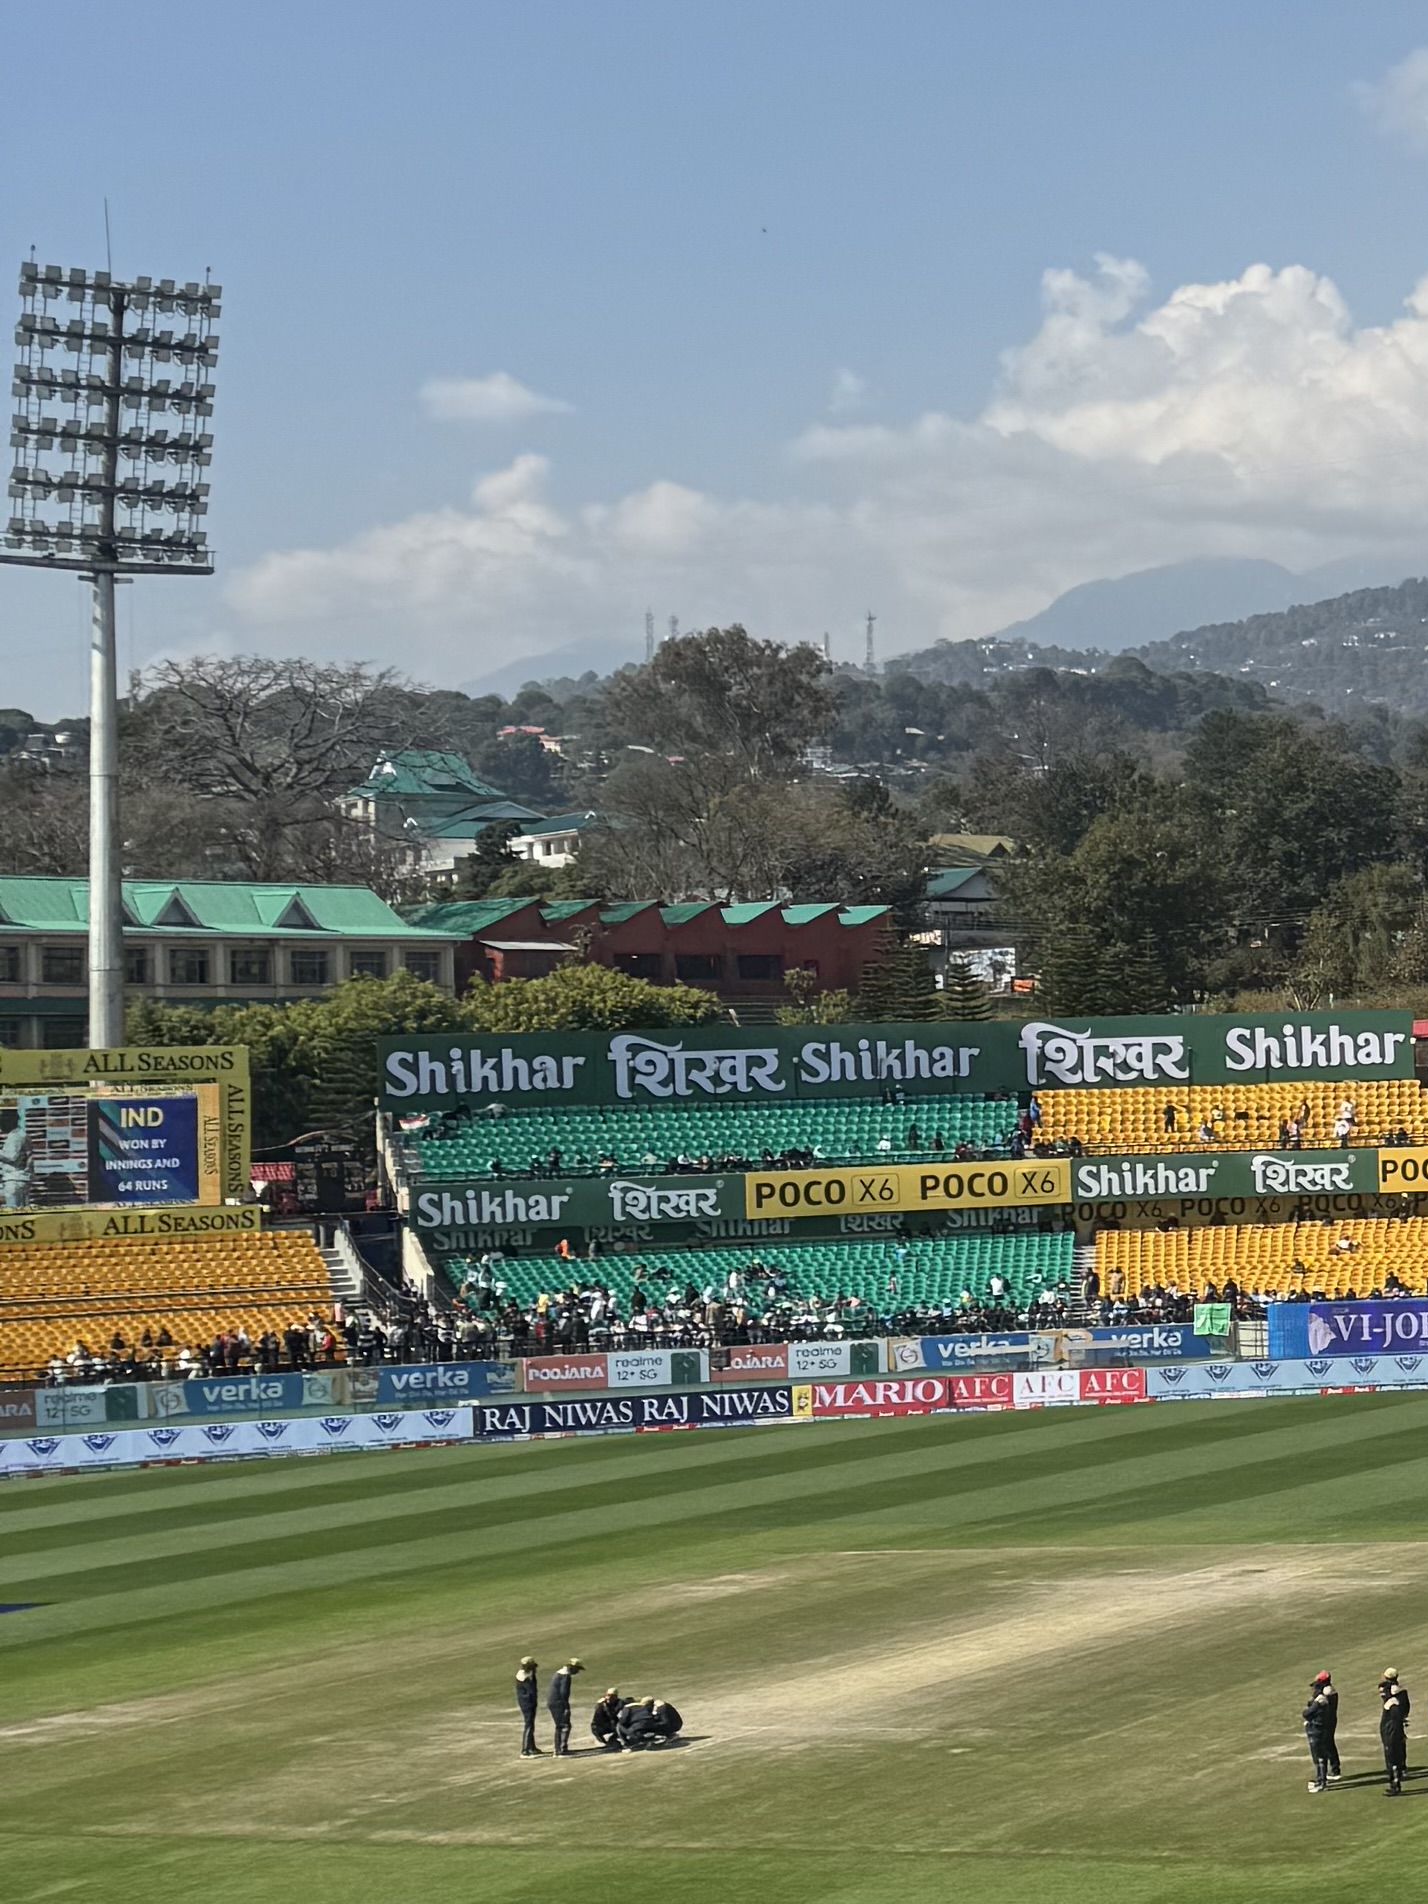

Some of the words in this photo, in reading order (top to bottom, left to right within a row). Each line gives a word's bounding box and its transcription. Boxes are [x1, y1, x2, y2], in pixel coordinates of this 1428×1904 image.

[84, 1052, 135, 1074] ALL
[138, 1050, 236, 1073] SEASONS
[801, 1038, 981, 1085] Shikhar
[1019, 1022, 1191, 1085] शिखर
[1225, 1023, 1406, 1071] Shikhar
[386, 1047, 586, 1097] Shikhar
[608, 1034, 787, 1098] शिखर
[120, 1106, 165, 1129] IND
[227, 1084, 244, 1122] ALL
[118, 1138, 150, 1150] WON
[151, 1138, 168, 1149] BY
[227, 1123, 244, 1193] SEASONS
[105, 1159, 153, 1171] INNINGS
[154, 1158, 181, 1169] AND
[1077, 1161, 1216, 1198] Shikhar
[1250, 1154, 1354, 1195] शिखर
[118, 1180, 133, 1192] 64
[135, 1179, 169, 1191] RUNS
[755, 1179, 846, 1209] POCO
[858, 1177, 895, 1202] X6
[919, 1171, 1008, 1200] POCO
[1020, 1170, 1055, 1195] X6
[417, 1189, 570, 1228] Shikhar
[608, 1180, 722, 1222] शिखर
[103, 1215, 152, 1236] ALL
[157, 1210, 255, 1234] SEASONS
[615, 1356, 663, 1367] realme
[795, 1346, 843, 1358] realme
[203, 1377, 283, 1403] verka
[391, 1366, 469, 1390] verka
[954, 1374, 1010, 1398] AFC
[1020, 1373, 1076, 1396] AFC
[1085, 1370, 1142, 1394] AFC
[813, 1379, 945, 1409] MARIO
[484, 1405, 531, 1433] RAJ
[543, 1399, 633, 1430] NIWAS
[642, 1395, 689, 1423] RAJ
[701, 1389, 790, 1419] NIWAS
